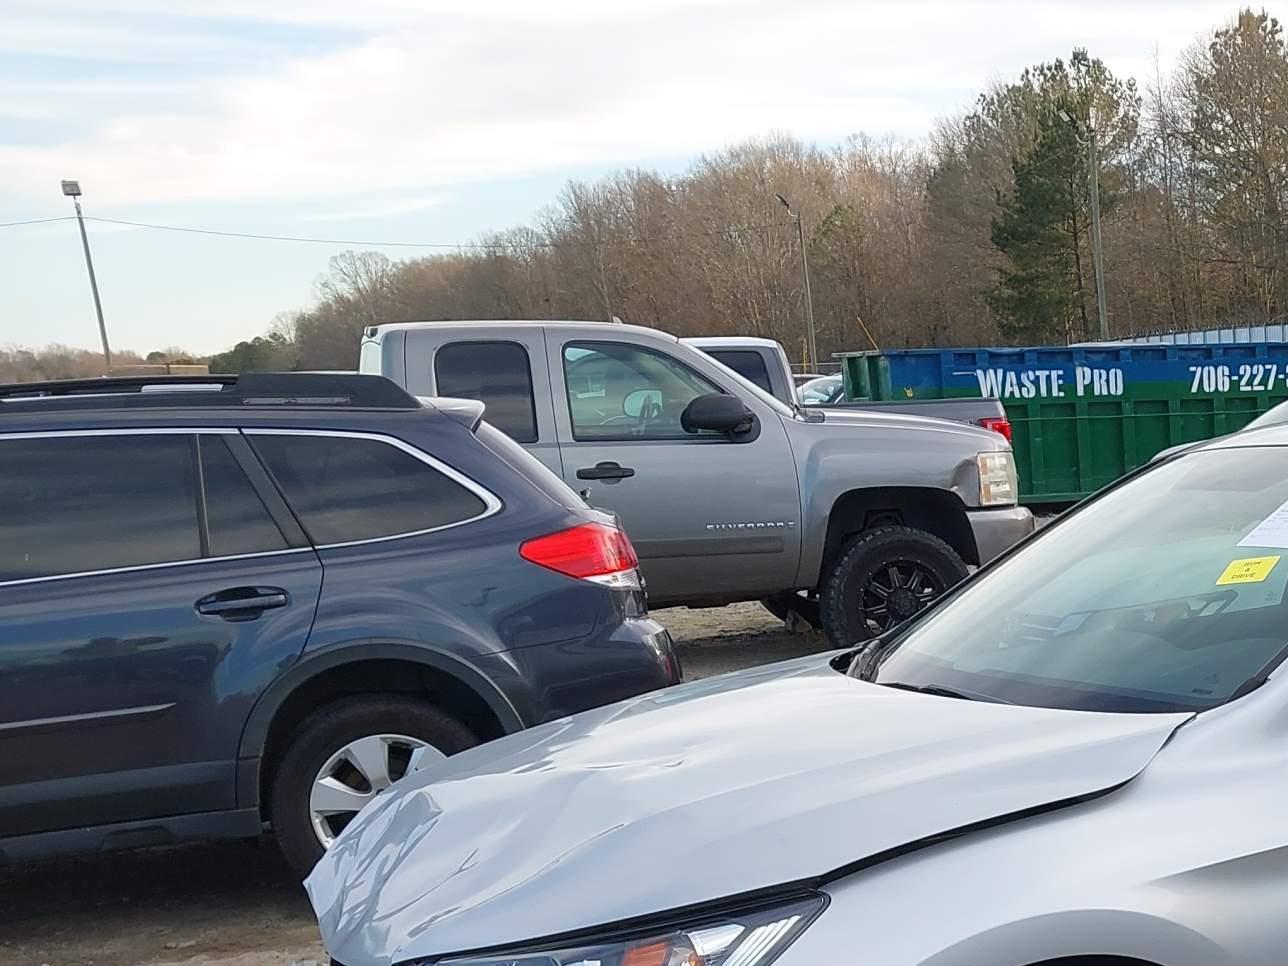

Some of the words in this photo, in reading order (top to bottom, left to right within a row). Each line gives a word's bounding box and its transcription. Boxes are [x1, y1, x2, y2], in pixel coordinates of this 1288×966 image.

[976, 367, 1065, 398] WASTE
[1076, 365, 1124, 397] PRO
[1231, 572, 1257, 580] DRIVE
